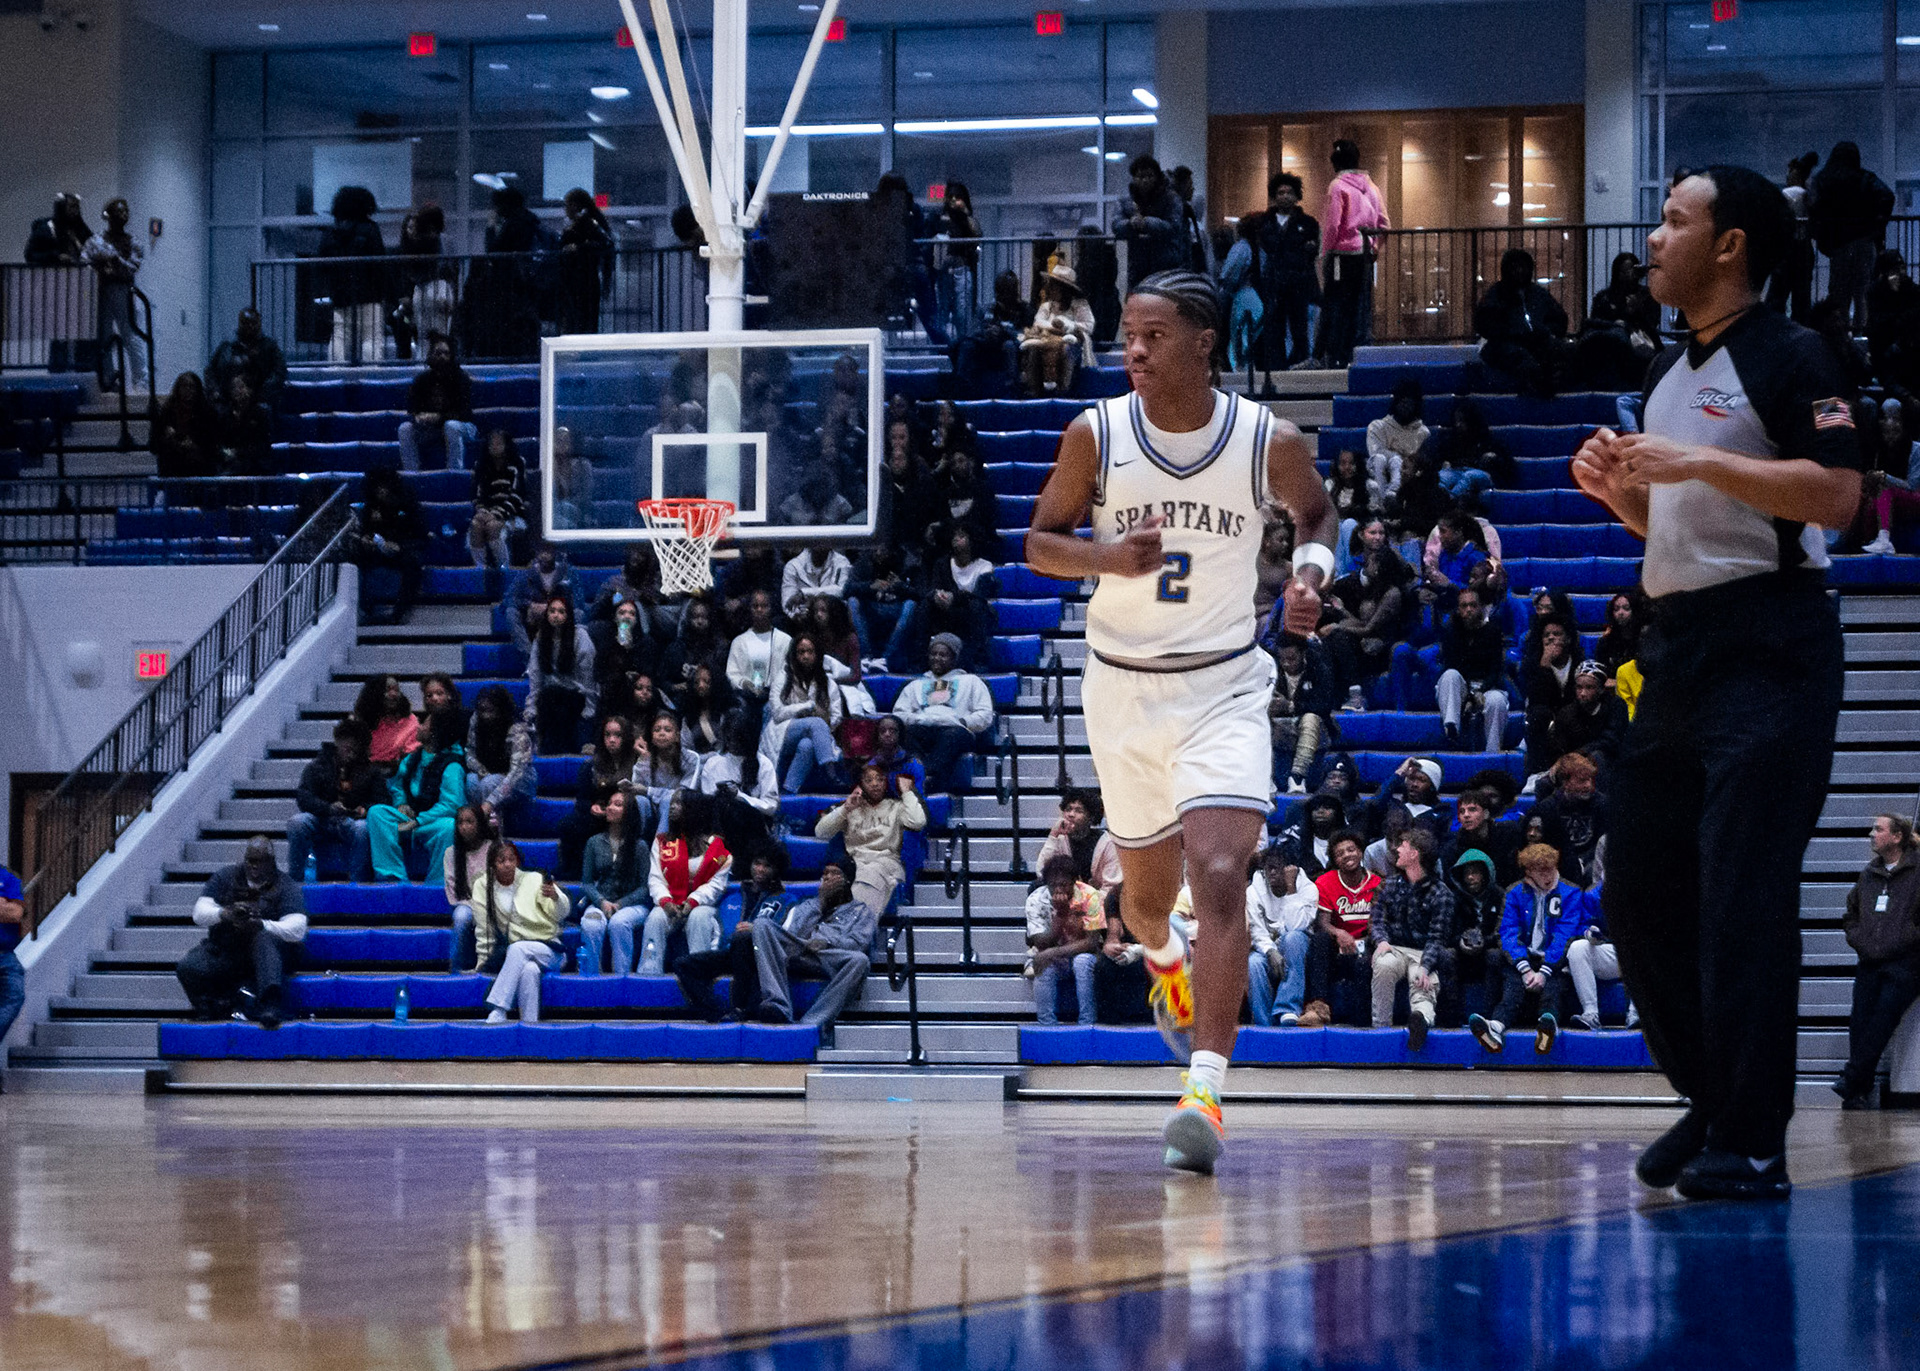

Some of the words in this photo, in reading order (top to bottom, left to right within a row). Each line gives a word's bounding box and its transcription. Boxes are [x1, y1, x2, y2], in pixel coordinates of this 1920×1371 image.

[802, 191, 870, 201] DAKTRONICS
[1690, 392, 1741, 409] GHSA
[1115, 501, 1245, 537] SPARTANS
[1156, 551, 1192, 604] 2
[138, 652, 167, 678] EXIT
[1336, 896, 1371, 914] Panthe
[1548, 896, 1562, 915] C
